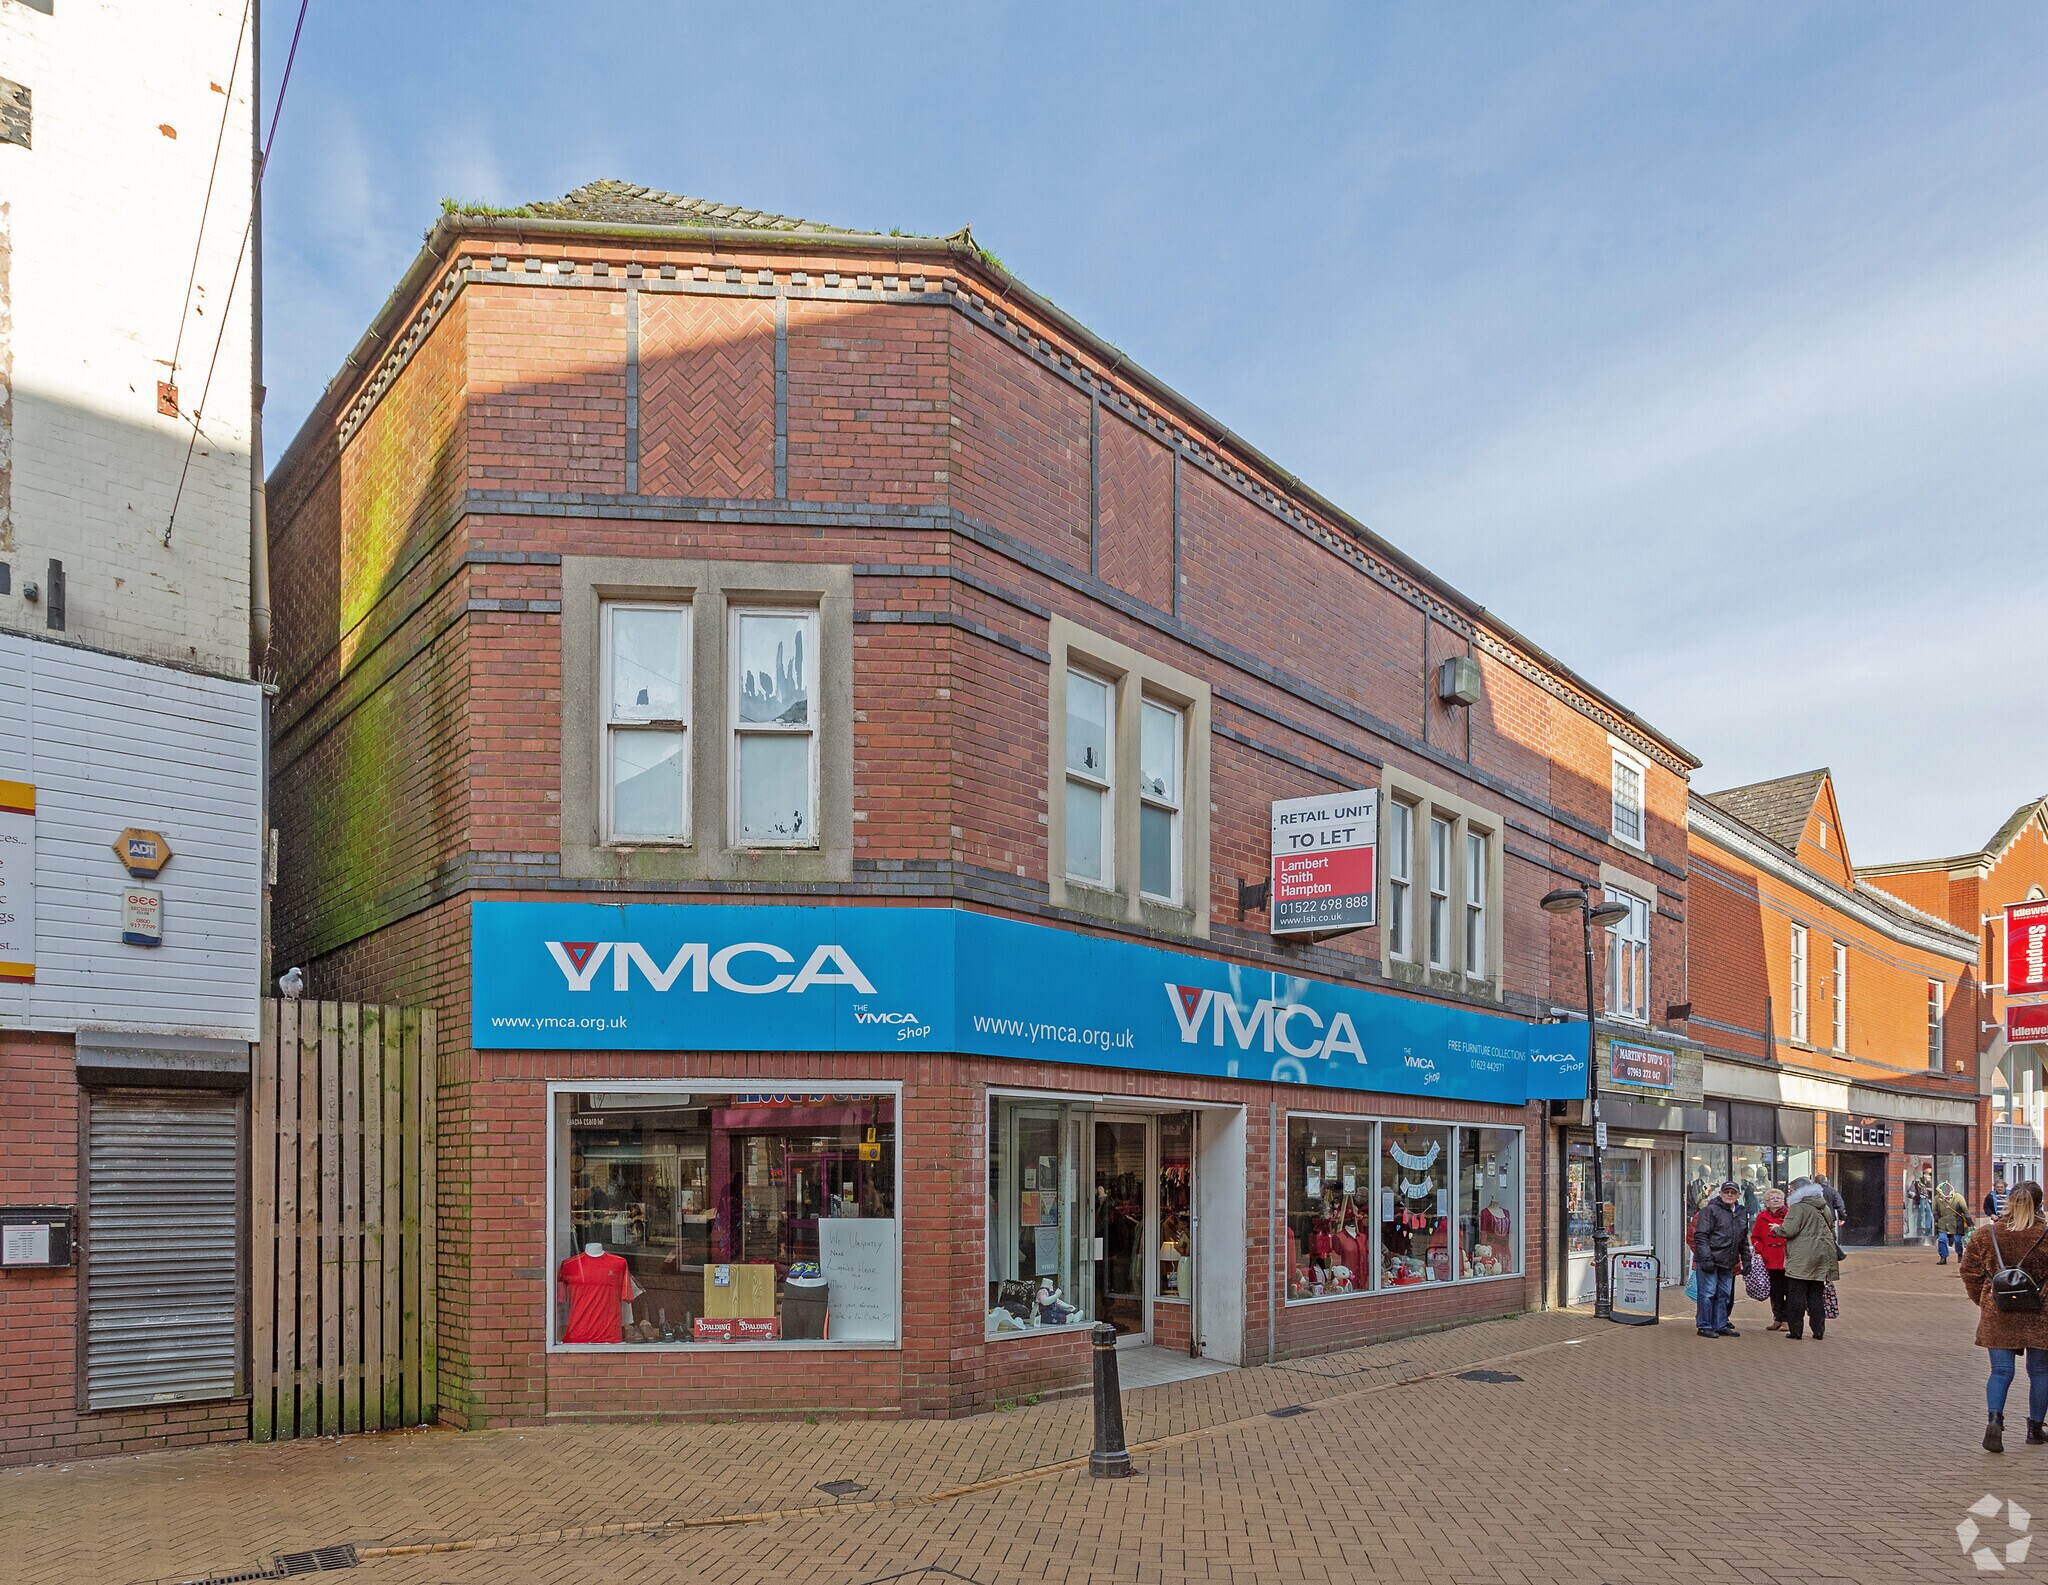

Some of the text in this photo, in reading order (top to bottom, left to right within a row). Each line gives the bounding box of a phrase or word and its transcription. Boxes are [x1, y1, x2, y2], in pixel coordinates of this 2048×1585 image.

[1280, 804, 1373, 825] RETAIL UNIT
[1288, 828, 1356, 848] TO LET
[129, 843, 157, 856] ADT
[1281, 856, 1329, 872] Lambert
[1280, 871, 1314, 884] Smith
[1281, 883, 1332, 897] Hampton
[128, 895, 158, 907] GEE
[1280, 895, 1369, 915] 01522 698 888
[1280, 912, 1342, 926] www.lsh.co.uk
[2026, 924, 2047, 984] Shopping
[544, 941, 878, 994] YMCA
[853, 1004, 868, 1012] THE
[491, 1014, 628, 1031] www.ymca.org.uk
[854, 1013, 919, 1024] YMCA
[1164, 982, 1368, 1065] YMCA
[896, 1024, 932, 1042] Shop
[973, 1015, 1135, 1050] www.ymca.org.uk
[1403, 1047, 1412, 1055] THE
[1447, 1039, 1527, 1062] FREE FURNITURE COLLECTIONS
[1619, 1048, 1663, 1066] MARTIN'S DVD'S
[1404, 1056, 1435, 1070] YMCA
[1530, 1054, 1576, 1063] YMCA
[1470, 1060, 1505, 1073] 01623 442971
[1559, 1062, 1585, 1074] Shop
[1627, 1067, 1642, 1078] 07963
[1642, 1069, 1652, 1079] 272
[1423, 1071, 1441, 1086] Shop
[1621, 1260, 1651, 1270] YMCA
[699, 1322, 731, 1331] SPALDING
[741, 1322, 773, 1331] SPALDING
